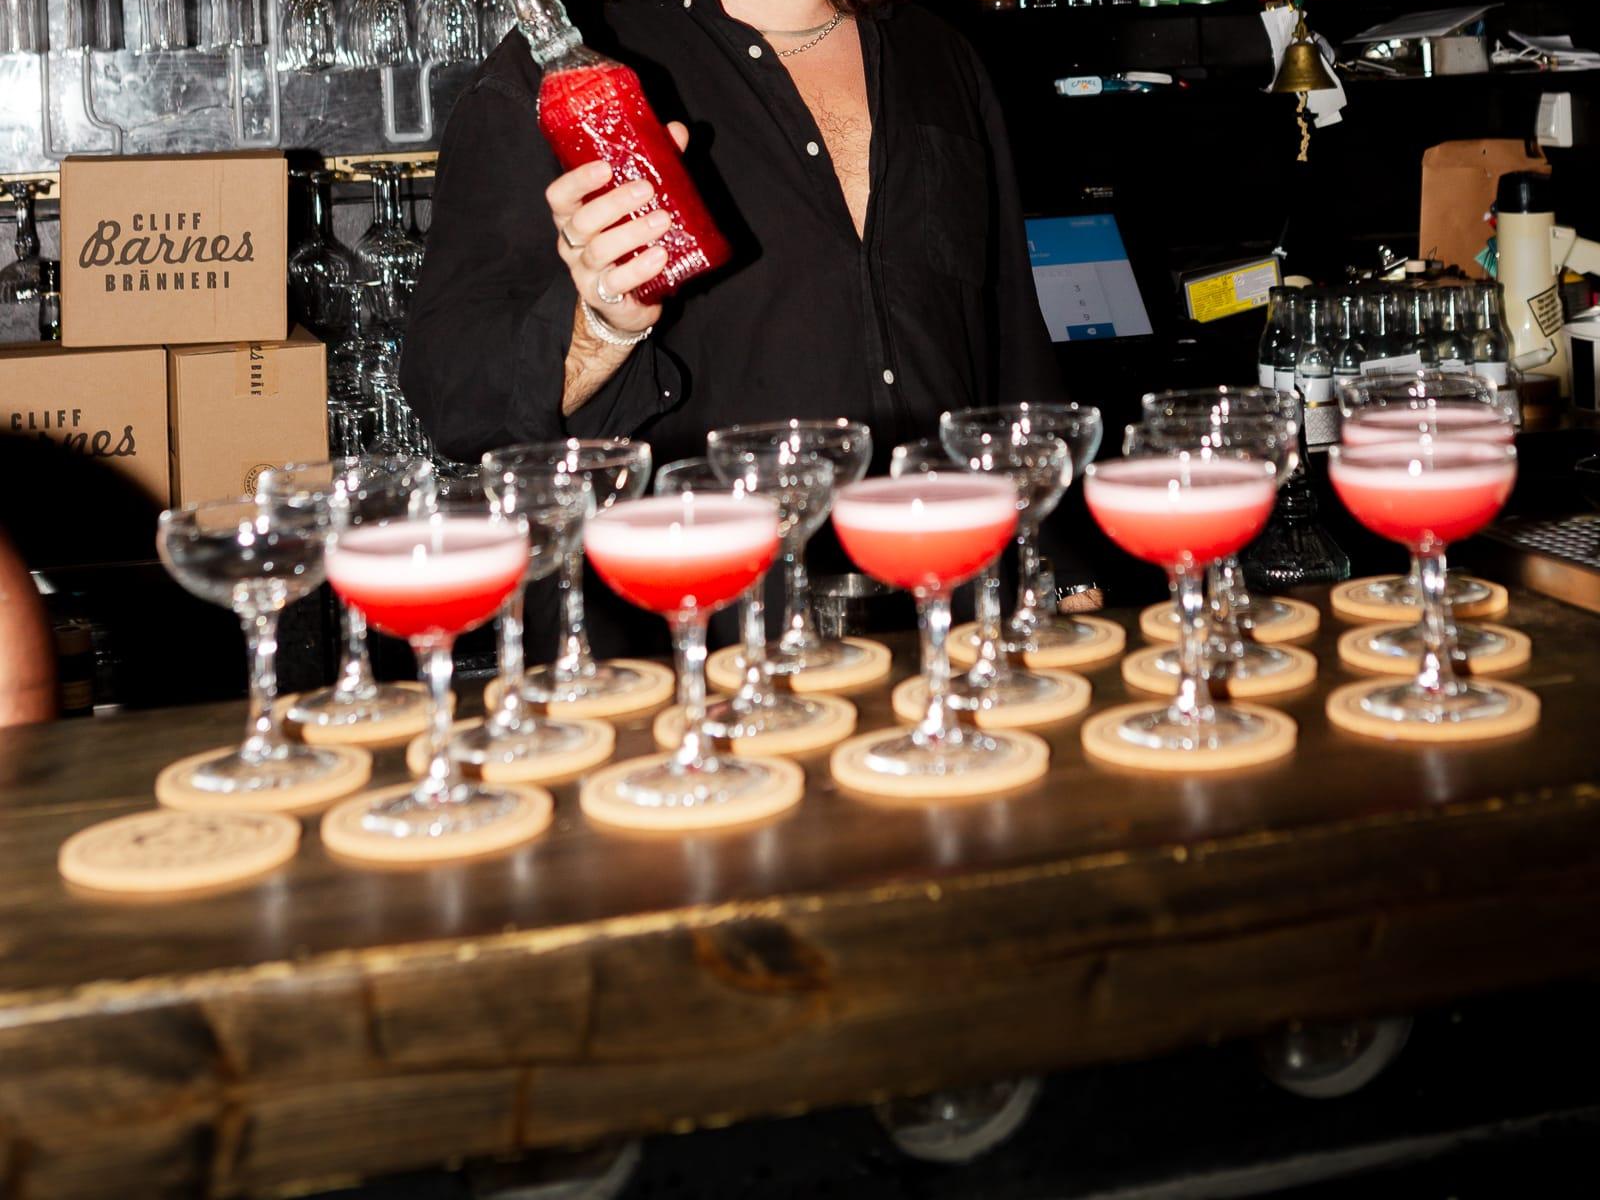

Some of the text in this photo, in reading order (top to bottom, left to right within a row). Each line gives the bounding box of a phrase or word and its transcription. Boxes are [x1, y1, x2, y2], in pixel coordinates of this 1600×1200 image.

[132, 212, 201, 232] CLIFF
[78, 218, 255, 269] Barnes
[104, 269, 231, 292] BRÄNNERI
[11, 408, 82, 431] CLIFF
[60, 424, 137, 457] nes
